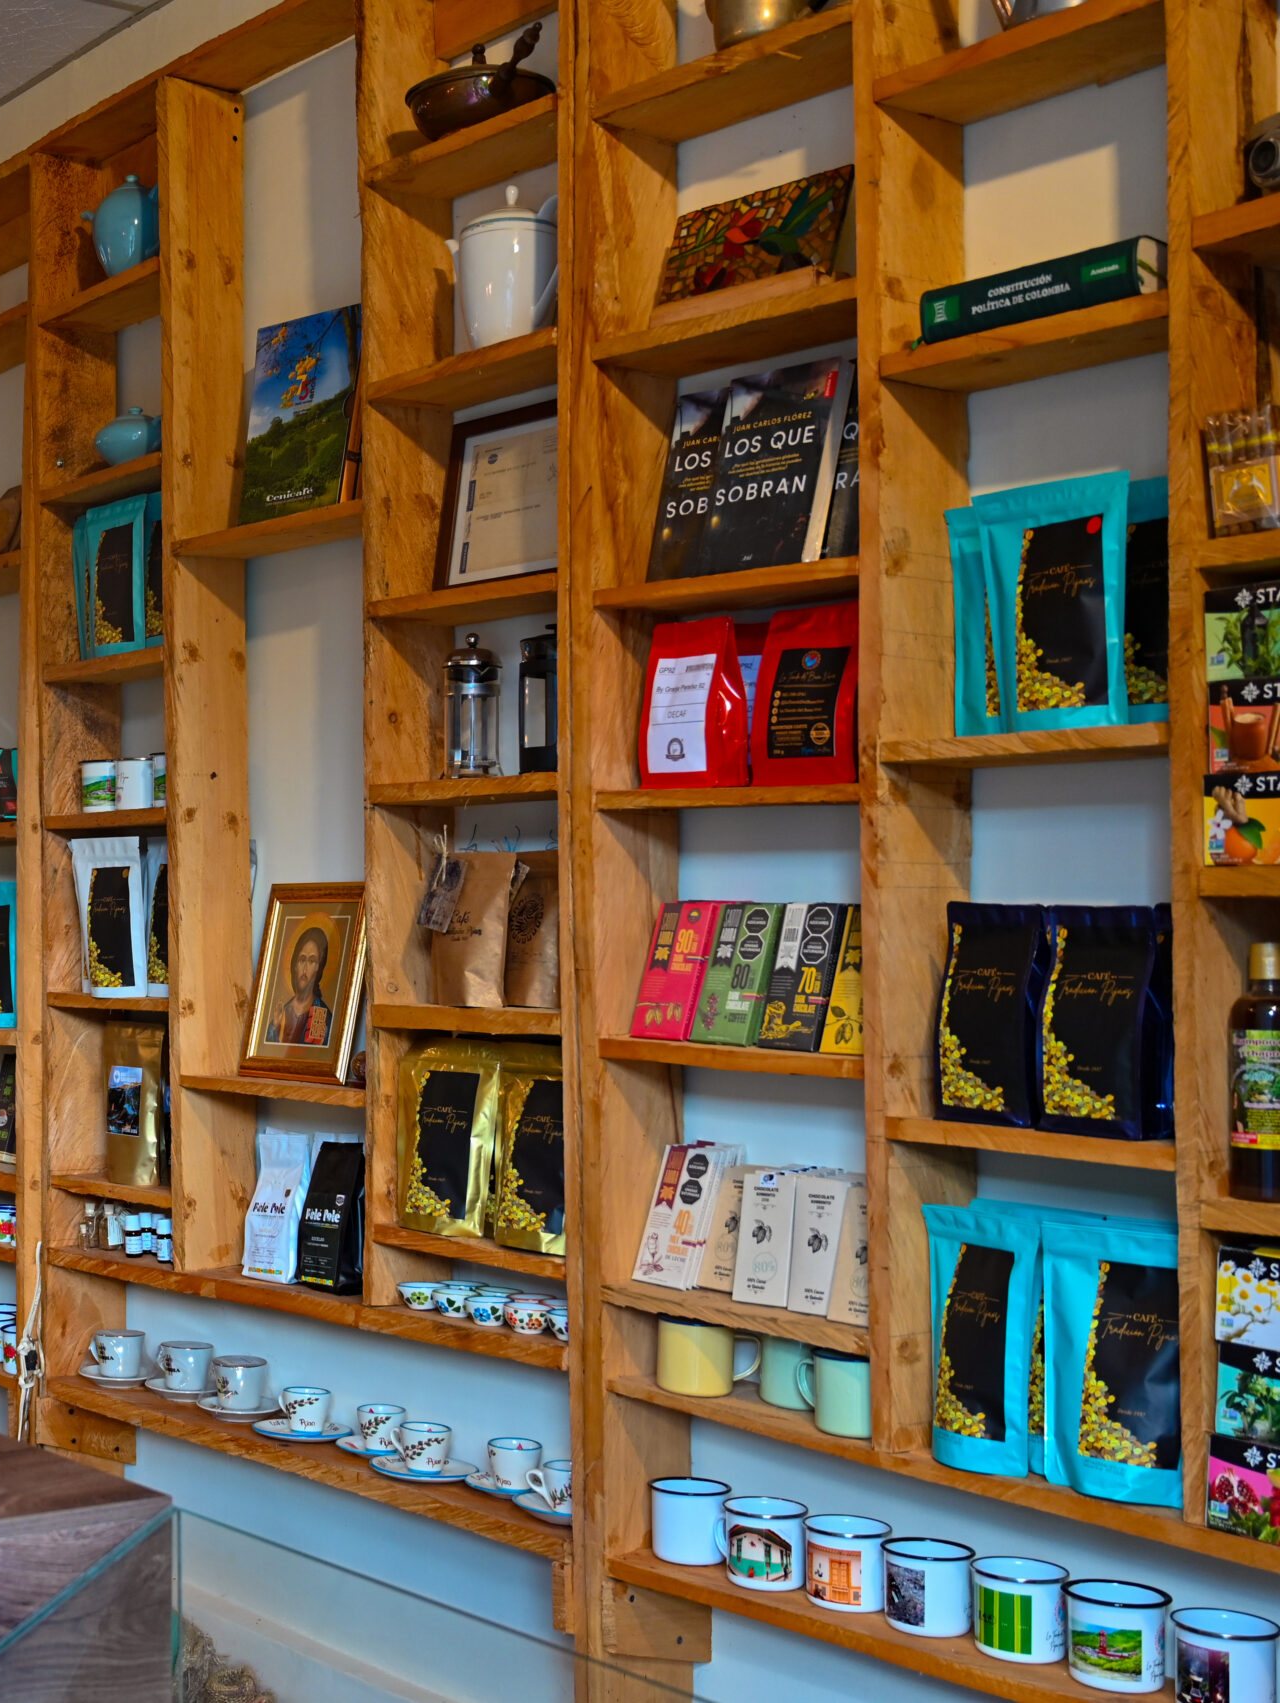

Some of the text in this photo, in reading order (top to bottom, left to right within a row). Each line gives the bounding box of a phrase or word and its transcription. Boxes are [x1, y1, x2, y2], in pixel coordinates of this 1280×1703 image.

[1090, 264, 1119, 277] Anotada
[987, 274, 1053, 298] CONSTITUCIÓN
[971, 282, 1071, 315] POLÍTICA DE COLOMBIA
[732, 410, 813, 435] JUAN CARLOS FLÓREZ
[683, 433, 720, 449] JUAN CARL
[724, 435, 762, 459] LOS
[770, 425, 816, 450] QUE
[674, 450, 712, 472] LOS
[265, 487, 314, 503] Cenicafé
[715, 474, 807, 507] SOBRAN
[667, 710, 687, 719] DECAF
[675, 928, 695, 954] 90
[730, 963, 751, 990] 80
[797, 966, 817, 994] 70
[977, 967, 997, 977] CAFÉ
[1087, 971, 1112, 981] CAFÉ
[437, 1106, 453, 1114] CAFÉ
[754, 1186, 779, 1194] CHOCOLATE
[808, 1193, 835, 1201] CHOCOLATE
[753, 1262, 776, 1273] 80%
[1133, 1313, 1158, 1324] CAFÉ
